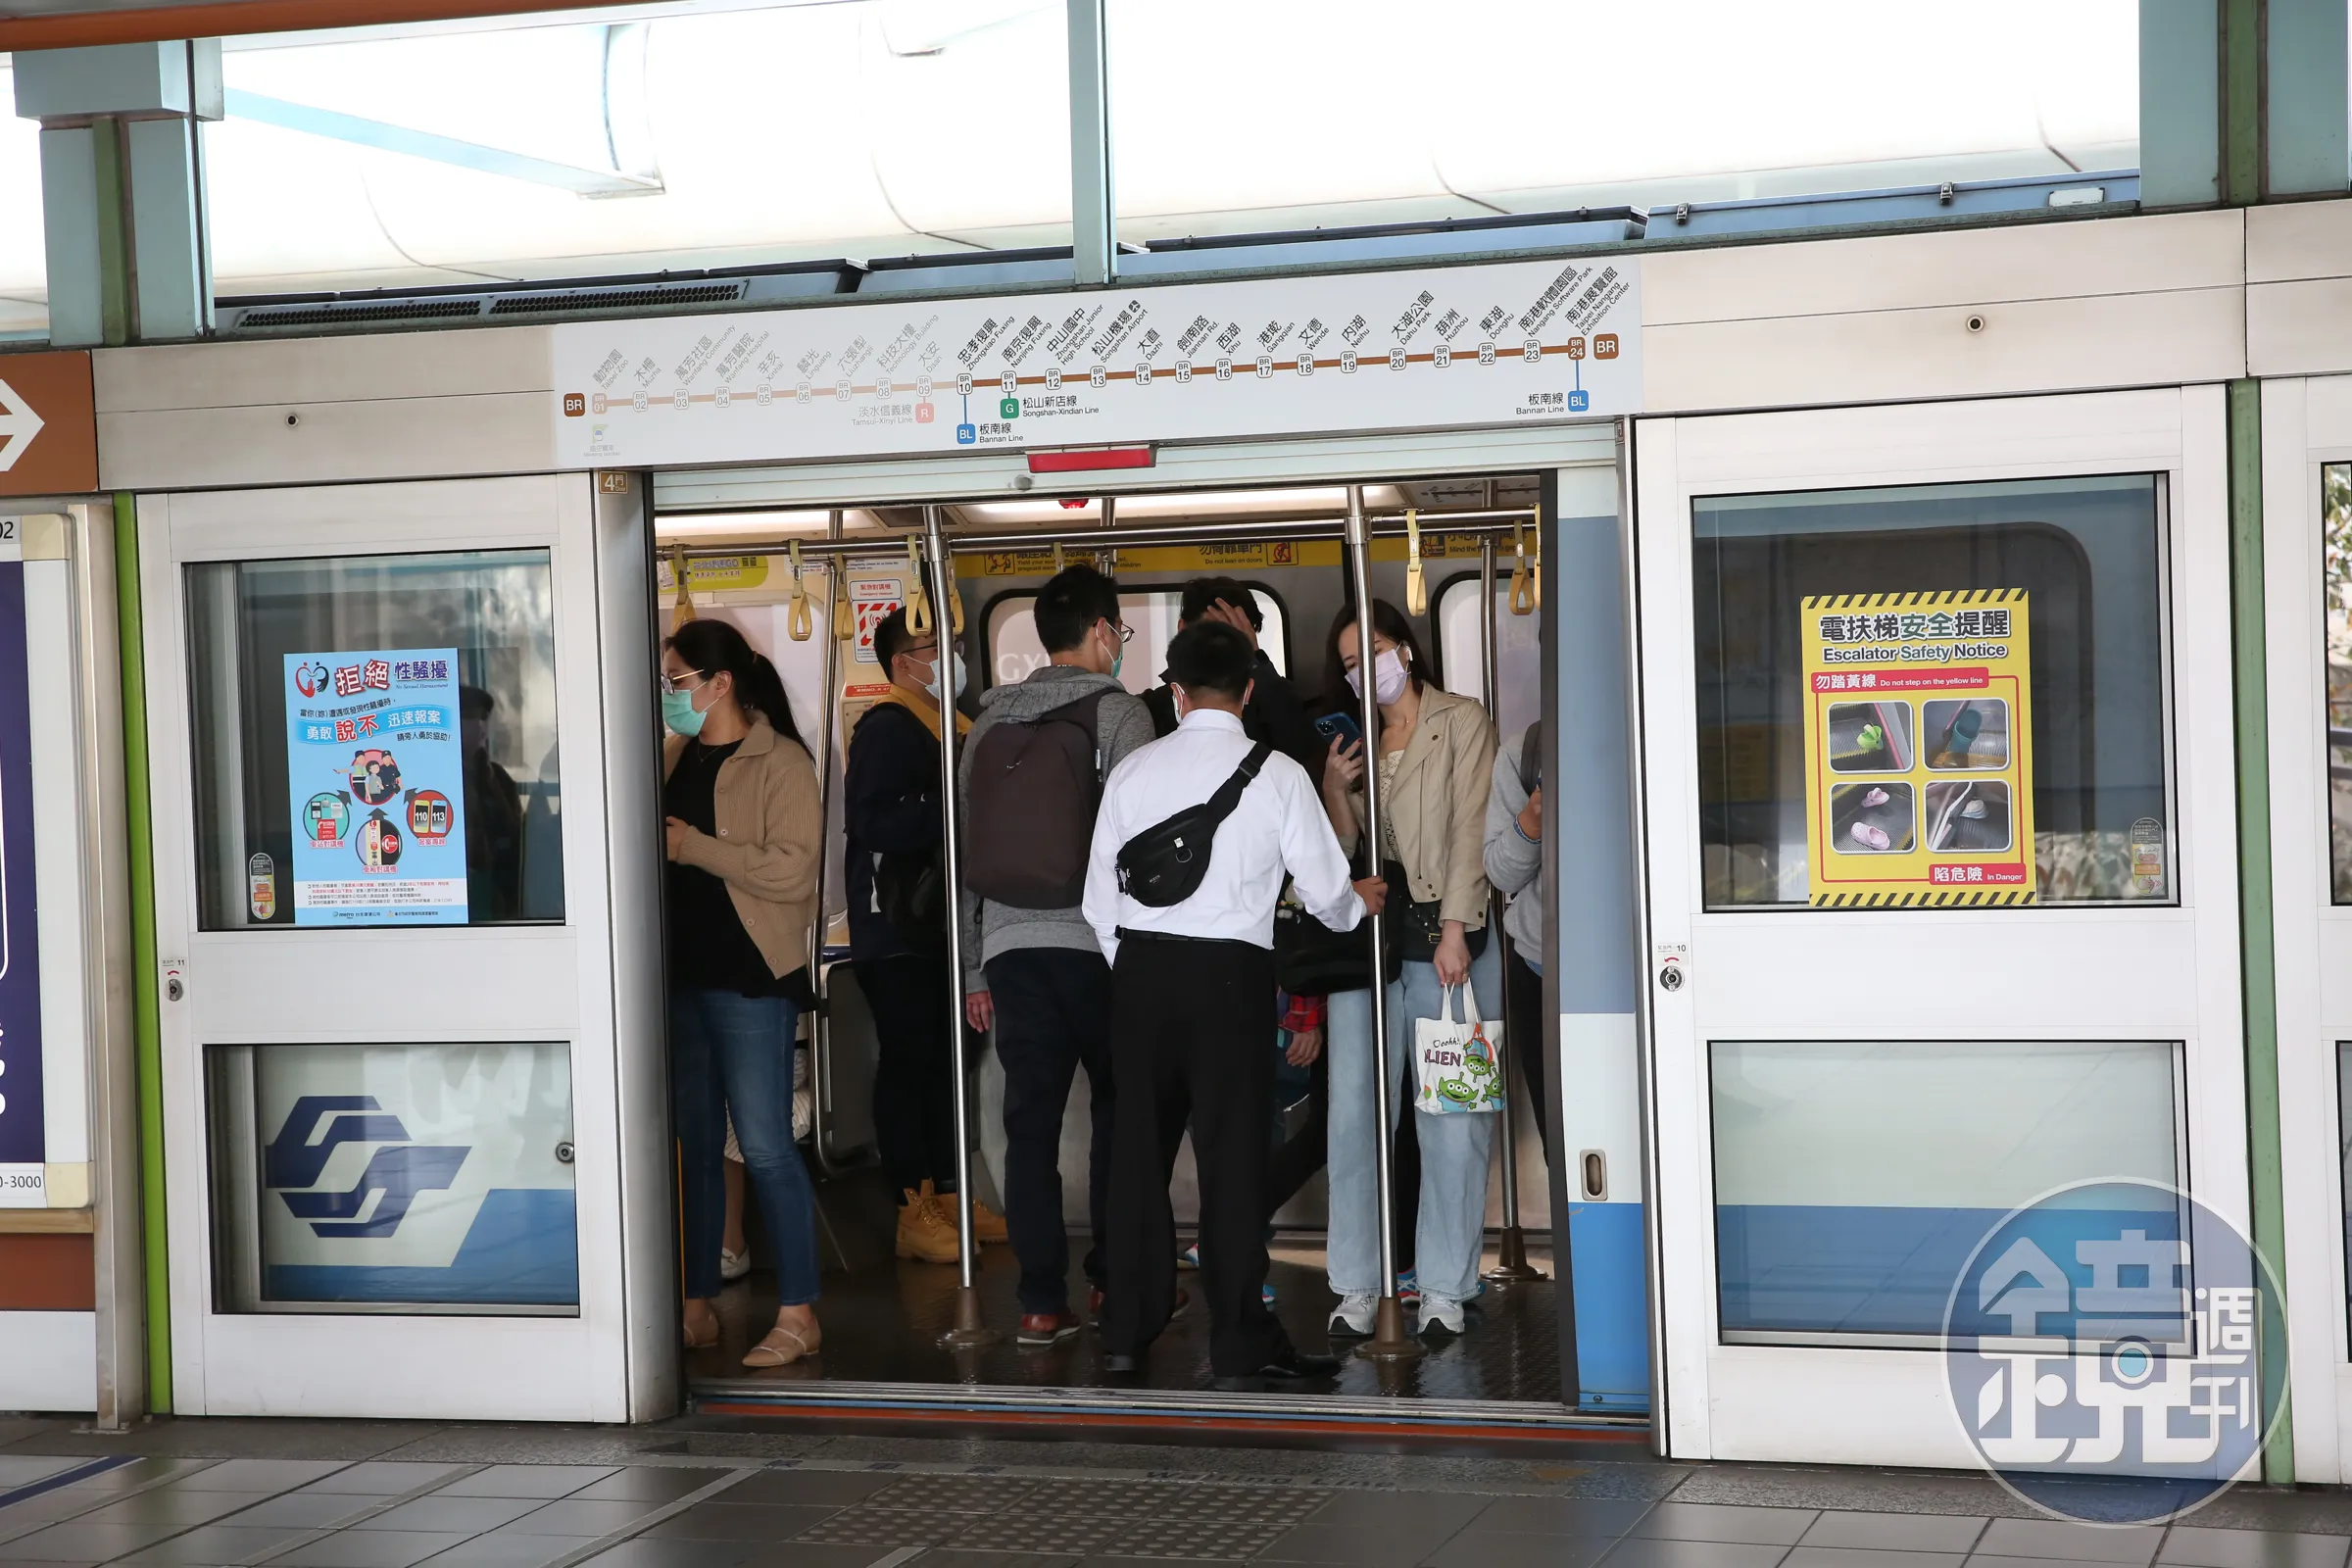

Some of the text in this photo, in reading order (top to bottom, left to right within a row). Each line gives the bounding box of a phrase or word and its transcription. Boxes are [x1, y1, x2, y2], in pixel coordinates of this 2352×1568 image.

[1518, 265, 1578, 331] 南港軟體園區
[1528, 266, 1593, 337] Nangang Software Park
[1565, 266, 1618, 324] 南港展覽館
[1392, 290, 1434, 339] 大湖公園
[1575, 283, 1620, 329] Taipei Nangang
[1581, 282, 1630, 336] Exhibition Center
[1400, 311, 1432, 345] Dahu Park
[1435, 308, 1460, 336] 葫洲
[1479, 305, 1505, 333] 東湖
[1489, 313, 1515, 340] Donghu
[1002, 315, 1043, 361] 南京復興
[1047, 308, 1085, 353] 中山國中
[1055, 304, 1104, 360] Zhongshan Junior
[1091, 310, 1132, 356] 松山機場
[1100, 309, 1148, 363] Songshan Airport
[1177, 315, 1209, 352] 劍南路
[1186, 322, 1220, 358] Jiannan Rd.
[1216, 323, 1241, 350] 西湖
[1257, 320, 1282, 347] 港墘
[1266, 321, 1295, 353] Gangqian
[1298, 318, 1323, 345] 文德
[1307, 327, 1330, 351] Wende
[1351, 329, 1370, 348] Neihu
[1445, 317, 1469, 343] Huzhou
[876, 323, 917, 368] 科技大樓
[886, 314, 939, 375] Technology Building
[958, 318, 998, 363] 忠孝復興
[966, 316, 1015, 370] Zhongxiao Fuxing
[1011, 322, 1052, 368] Nanjing Fuxing
[1061, 327, 1095, 366] High School
[1137, 328, 1161, 354] 大直
[1146, 341, 1163, 360] Dazhi
[1227, 340, 1241, 356] Xihu
[1597, 341, 1615, 353] BR
[674, 334, 713, 380] 萬芳社區
[683, 325, 736, 386] Wanfang Community
[716, 333, 754, 377] 萬芳醫院
[725, 331, 770, 384] Wanfang Hospital
[757, 350, 780, 374] 辛亥
[796, 349, 820, 374] 麟光
[837, 335, 866, 371] 六張犁
[846, 346, 874, 377] Liuzhangli
[918, 341, 941, 367] 大安
[1436, 356, 1448, 365] 21
[1481, 353, 1493, 363] 22
[1526, 351, 1539, 360] 23
[1570, 348, 1583, 357] 24
[592, 349, 623, 384] 動物園
[634, 357, 656, 382] 木柵
[766, 362, 784, 382] Xinhai
[806, 351, 831, 380] Linguang
[926, 356, 942, 373] Daan
[1218, 369, 1230, 377] 16
[1259, 366, 1271, 375] 17
[1300, 364, 1312, 373] 18
[1343, 361, 1355, 370] 19
[1392, 358, 1404, 368] 20
[601, 359, 628, 391] Taipei Zoo
[642, 367, 661, 388] Muzha
[1048, 378, 1059, 387] 12
[1093, 376, 1104, 385] 13
[1137, 373, 1150, 382] 14
[1178, 371, 1190, 380] 15
[838, 390, 849, 399] 07
[878, 388, 889, 397] 08
[918, 385, 930, 394] 09
[959, 383, 971, 392] 10
[1004, 381, 1014, 390] 11
[566, 400, 583, 411] BR
[676, 398, 687, 407] 03
[717, 396, 728, 405] 04
[759, 394, 770, 403] 05
[798, 392, 809, 401] 06
[1023, 396, 1077, 408] 松山新店線
[1528, 393, 1563, 405] 板南線
[1571, 396, 1585, 406] BL
[859, 404, 912, 417] 淡水信義線
[921, 409, 928, 417] R
[1006, 404, 1013, 413] G
[1023, 408, 1083, 417] Songshan-Xindian
[852, 418, 896, 426] Tamsui-Xinyi
[980, 423, 1011, 434] 板南線
[960, 430, 972, 438] BL
[605, 474, 615, 491] 4
[615, 475, 623, 485] 門
[1820, 610, 2009, 641] 電扶梯安全提醒
[1823, 643, 2006, 662] Escalator Safety Notice
[335, 660, 448, 696] 拒絕 性騷擾
[1816, 674, 1876, 689] 勿踏黃線
[1905, 679, 1921, 687] step
[1946, 678, 1968, 686] yellow
[307, 710, 441, 742] 勇敢 說不 迅速報案
[416, 812, 427, 821] 110
[432, 812, 445, 821] 113
[1934, 867, 1983, 882] 陷危險
[1996, 873, 2022, 881] Danger
